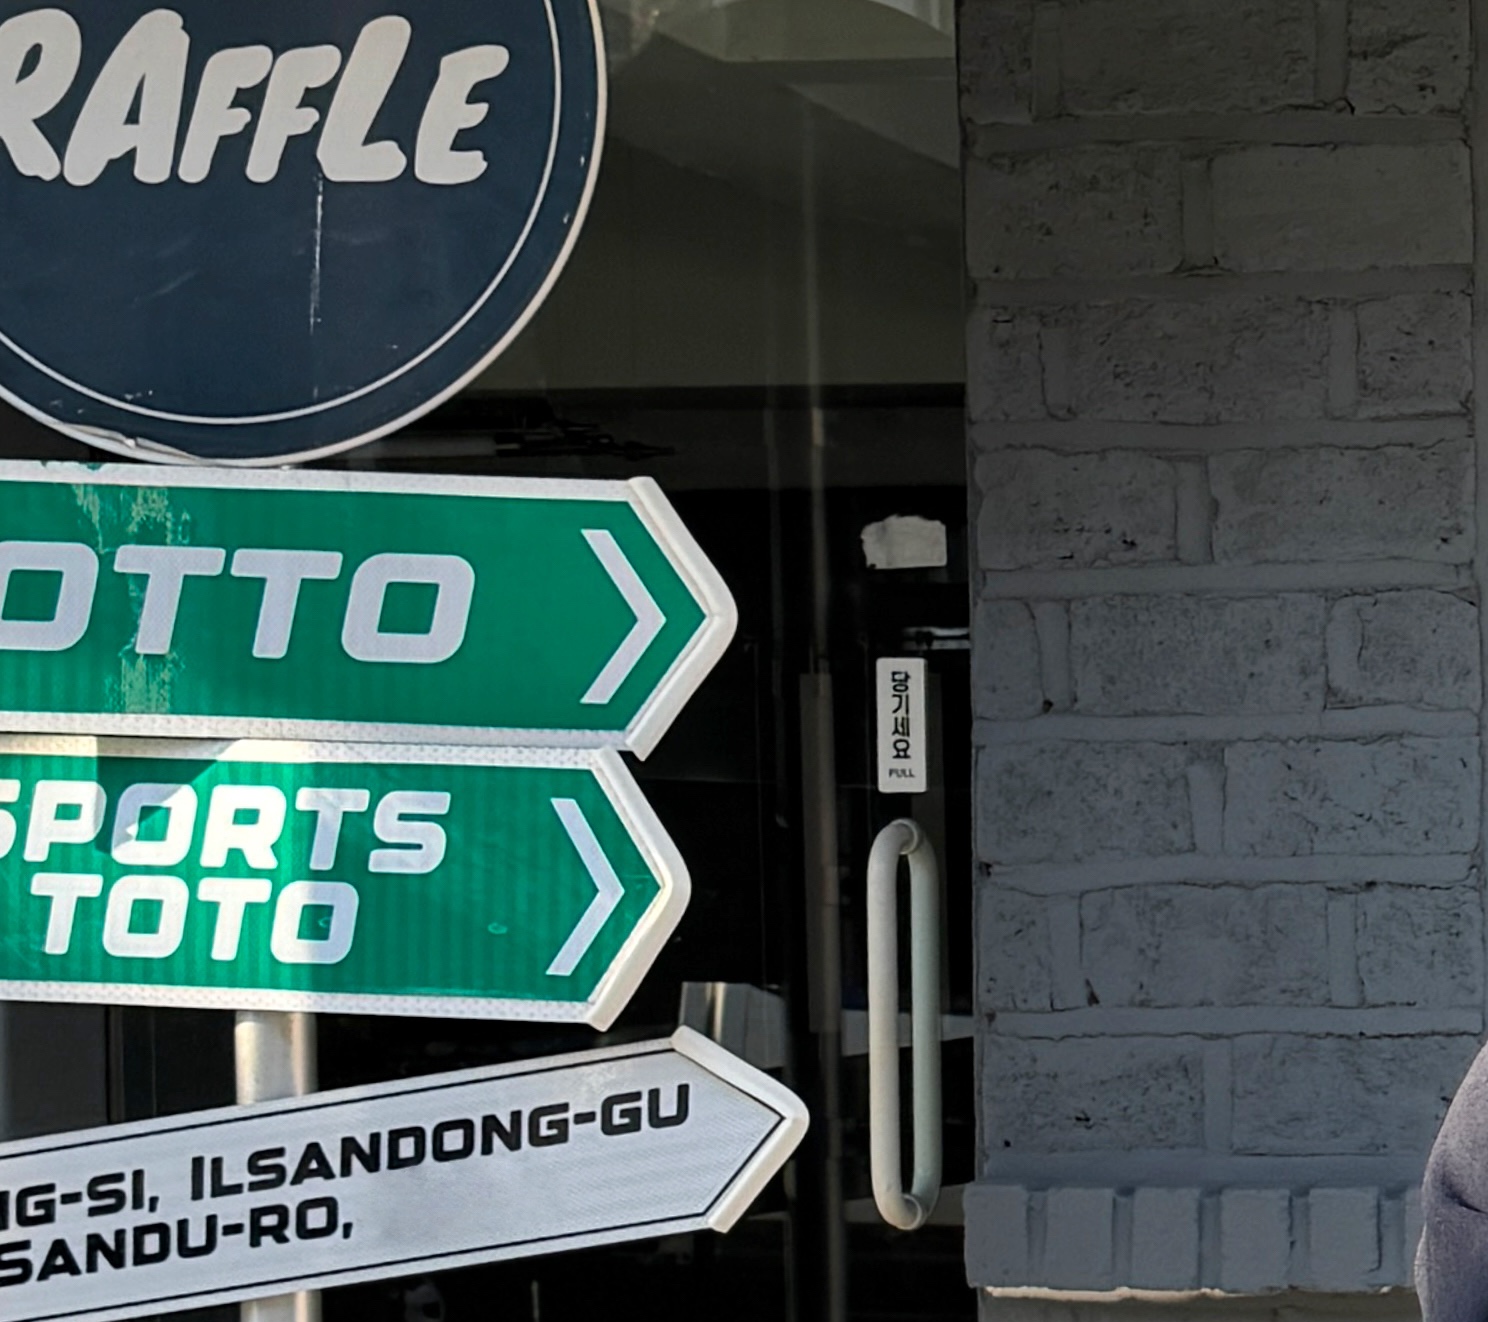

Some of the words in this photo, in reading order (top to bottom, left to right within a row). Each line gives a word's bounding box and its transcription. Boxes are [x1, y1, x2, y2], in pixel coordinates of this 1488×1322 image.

[0, 9, 509, 186] RAFFLE
[891, 671, 911, 759] 당기세요
[0, 778, 451, 873] PORTS
[30, 872, 359, 964] TOTO
[0, 1169, 159, 1231] G-SI,
[191, 1083, 691, 1200] ILSANDONG-GU
[0, 1196, 353, 1287] SANDU-RO,
